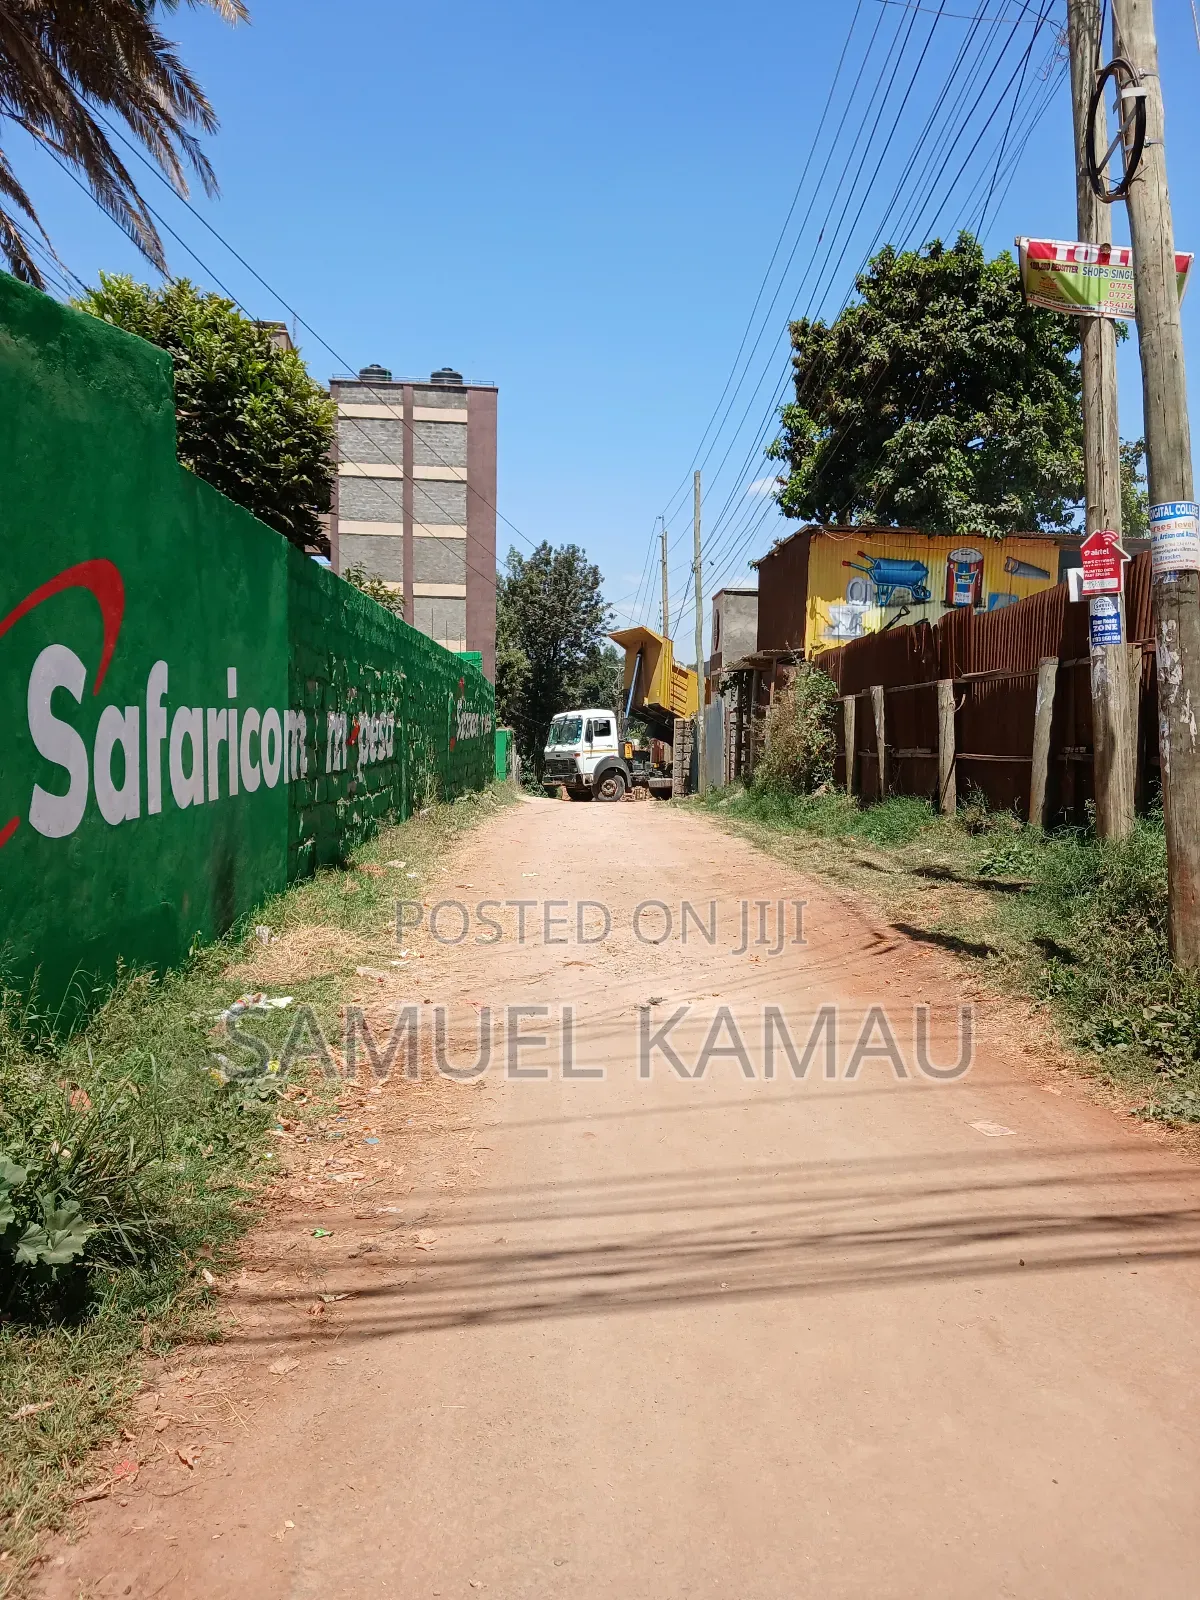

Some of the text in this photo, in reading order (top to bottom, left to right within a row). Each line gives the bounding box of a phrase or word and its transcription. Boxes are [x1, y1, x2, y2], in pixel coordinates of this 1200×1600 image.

[1052, 243, 1134, 268] TO L
[1082, 266, 1109, 278] SHOPS
[1151, 521, 1194, 532] rses level
[1090, 547, 1109, 556] airtel
[1092, 623, 1118, 632] ZONE
[27, 643, 307, 839] Safaricom
